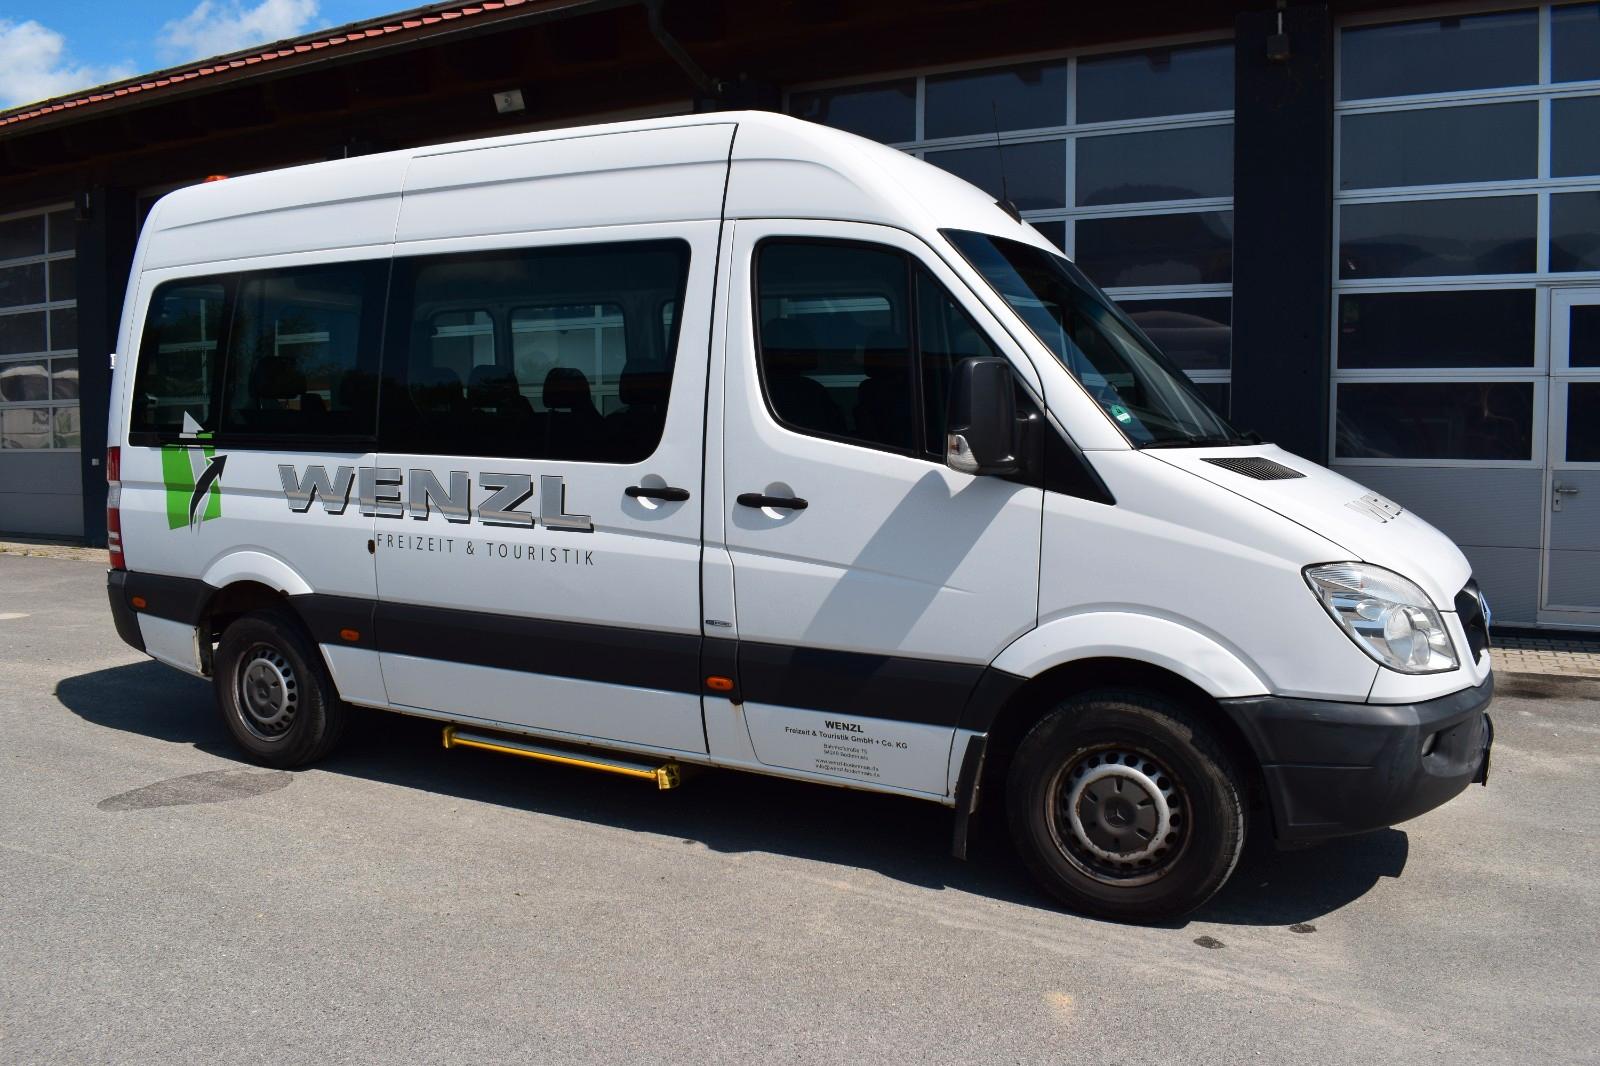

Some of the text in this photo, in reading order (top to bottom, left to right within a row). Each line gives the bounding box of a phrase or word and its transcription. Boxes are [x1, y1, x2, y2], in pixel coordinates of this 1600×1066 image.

[277, 463, 595, 533] WENZL
[376, 533, 594, 566] FREIZEIT & TOURISTIK
[785, 726, 810, 736] Freizeit
[819, 731, 849, 741] Touristik
[851, 735, 874, 745] GmbH
[881, 740, 894, 748] Co.
[895, 741, 908, 749] KG
[824, 720, 864, 733] WENZL
